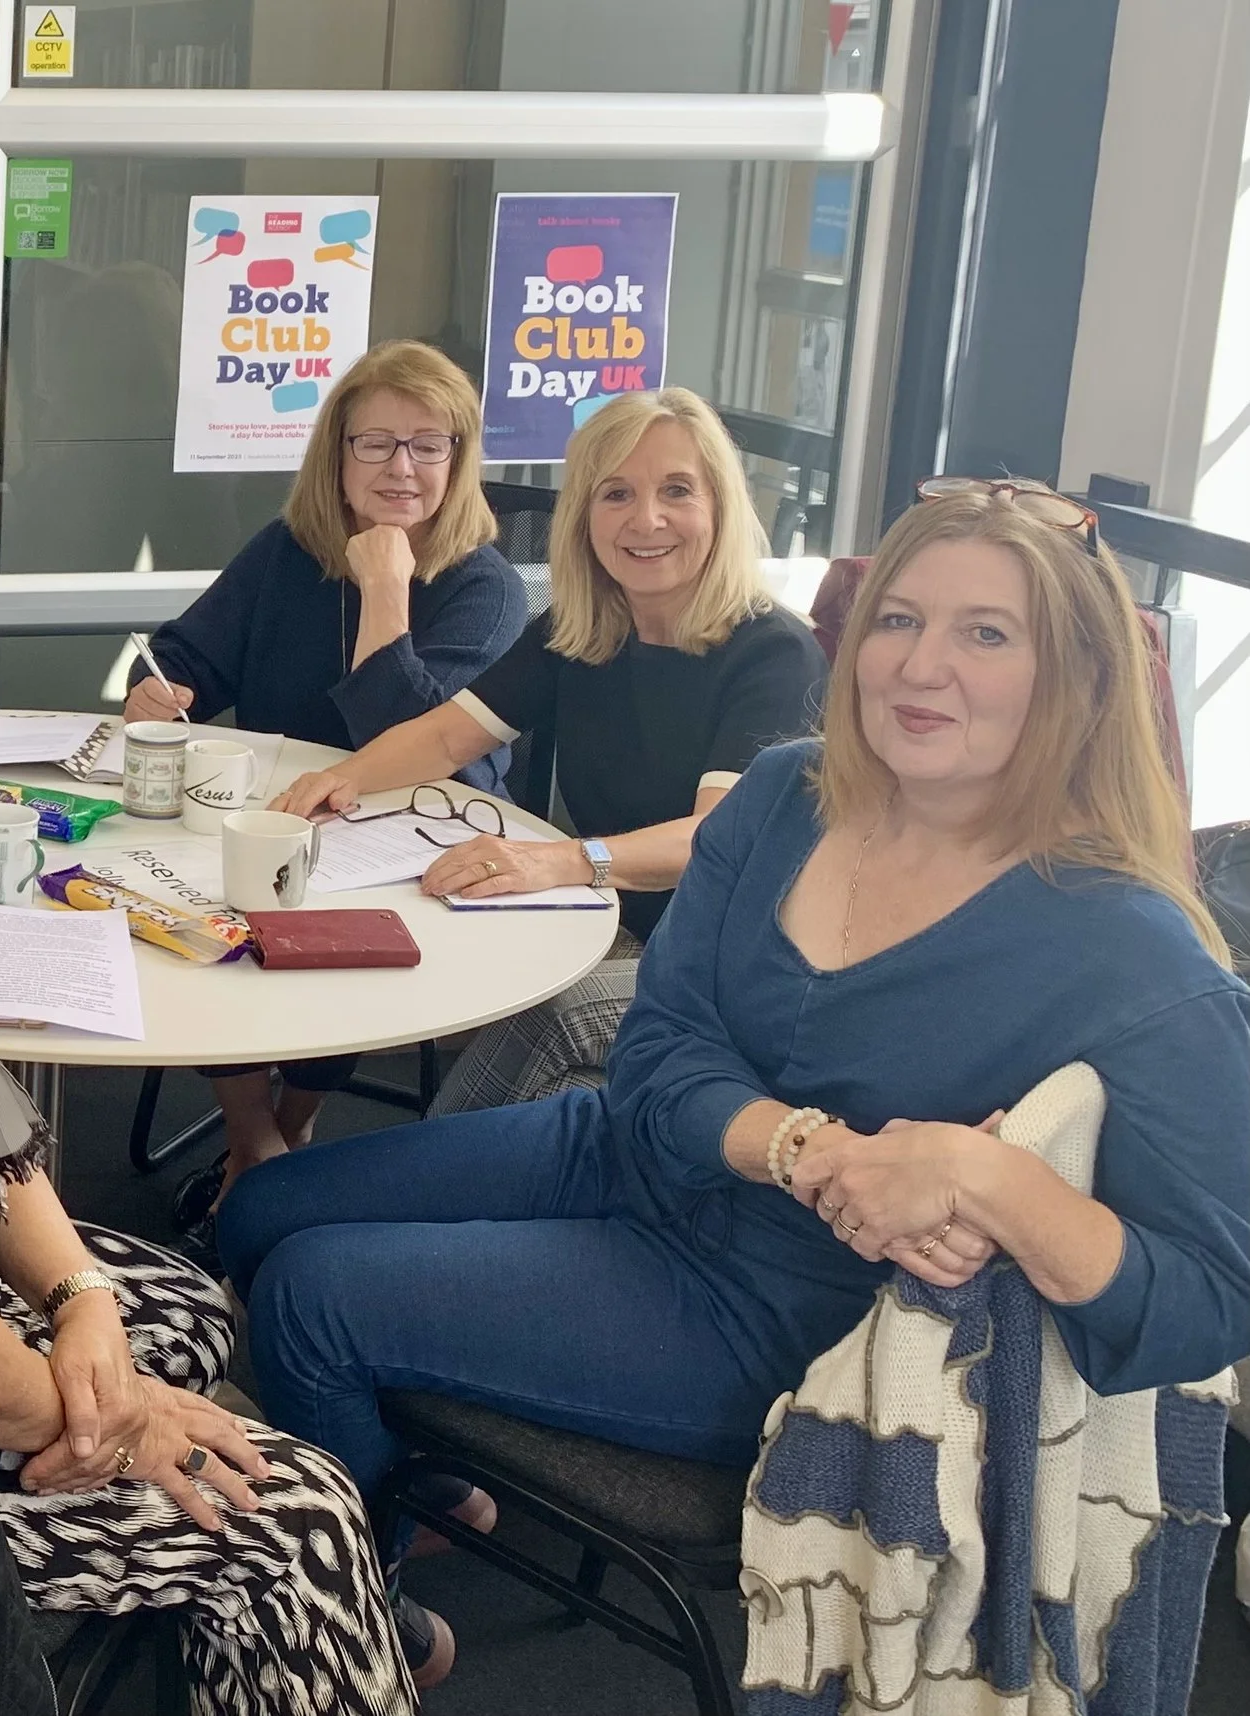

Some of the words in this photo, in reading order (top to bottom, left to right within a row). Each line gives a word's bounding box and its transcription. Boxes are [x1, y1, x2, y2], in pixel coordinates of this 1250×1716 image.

[35, 42, 62, 51] CCTV
[30, 62, 66, 71] operation
[227, 284, 330, 314] Book
[522, 275, 644, 314] Book
[221, 317, 331, 353] Club
[514, 316, 645, 360] Club
[216, 355, 290, 390] Day
[294, 357, 332, 378] UK
[507, 362, 597, 406] Day
[601, 365, 646, 390] UK
[270, 423, 297, 431] people
[121, 849, 223, 907] Reserved
[204, 906, 248, 928] for
